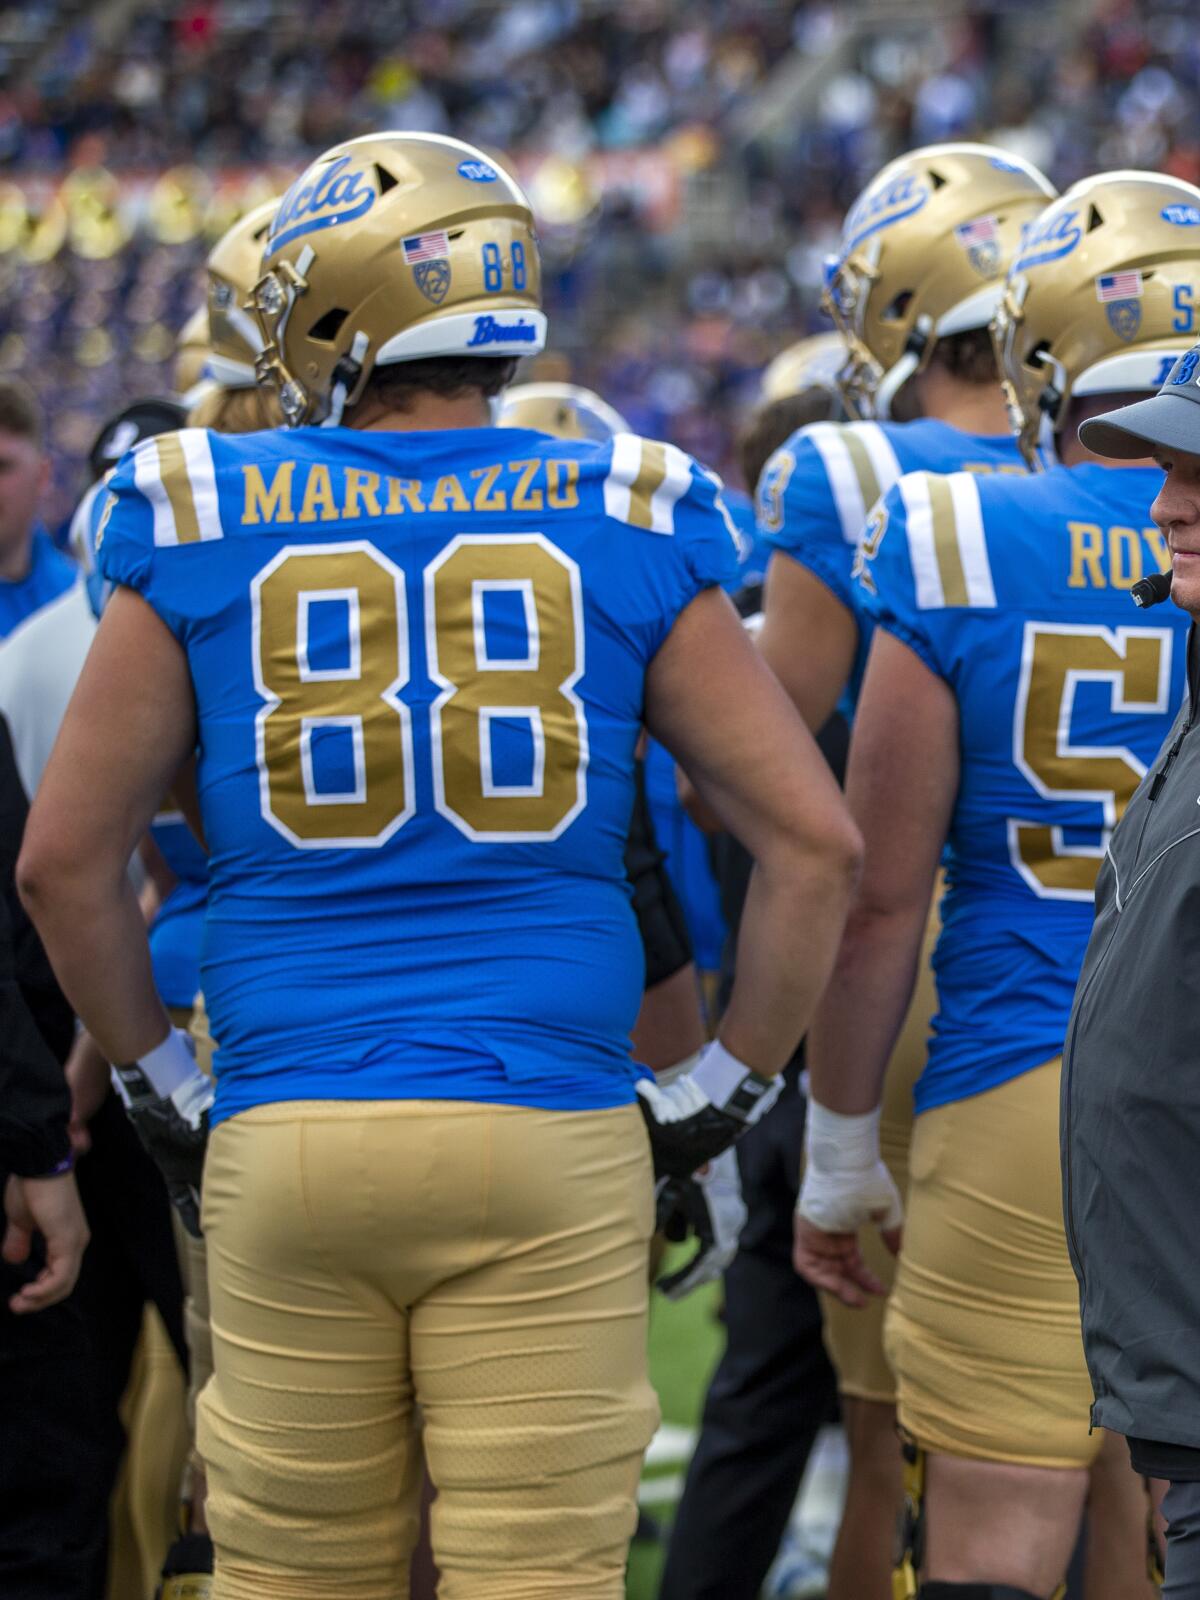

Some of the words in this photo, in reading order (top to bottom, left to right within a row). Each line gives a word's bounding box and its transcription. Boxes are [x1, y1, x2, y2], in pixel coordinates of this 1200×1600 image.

[482, 241, 527, 292] 88
[467, 316, 537, 347] Bruins
[241, 458, 580, 526] MARRAZZO
[251, 532, 588, 849] 88
[1008, 621, 1188, 902] 5
